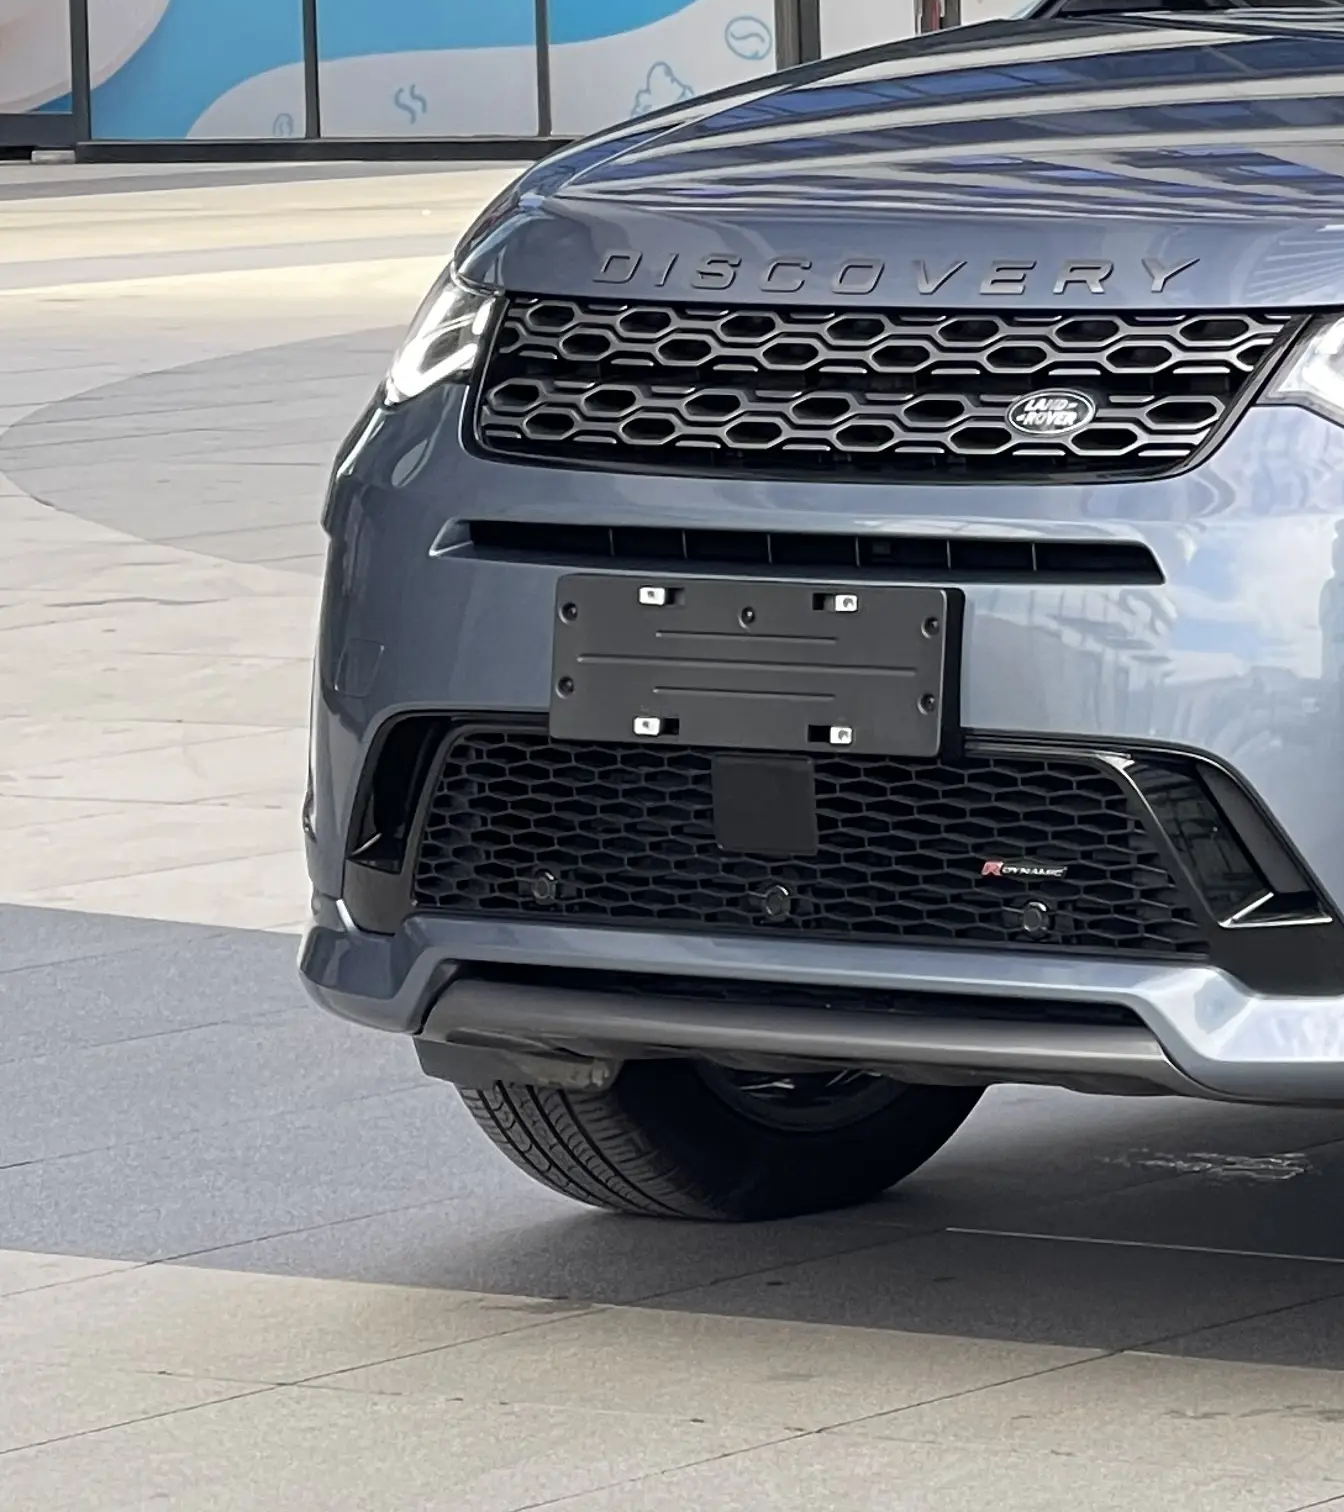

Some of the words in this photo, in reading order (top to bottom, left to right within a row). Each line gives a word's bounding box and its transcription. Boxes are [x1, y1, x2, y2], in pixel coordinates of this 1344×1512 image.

[593, 249, 1201, 295] DISCOVERY
[1024, 398, 1069, 411] LAND
[1023, 411, 1077, 426] ROVER
